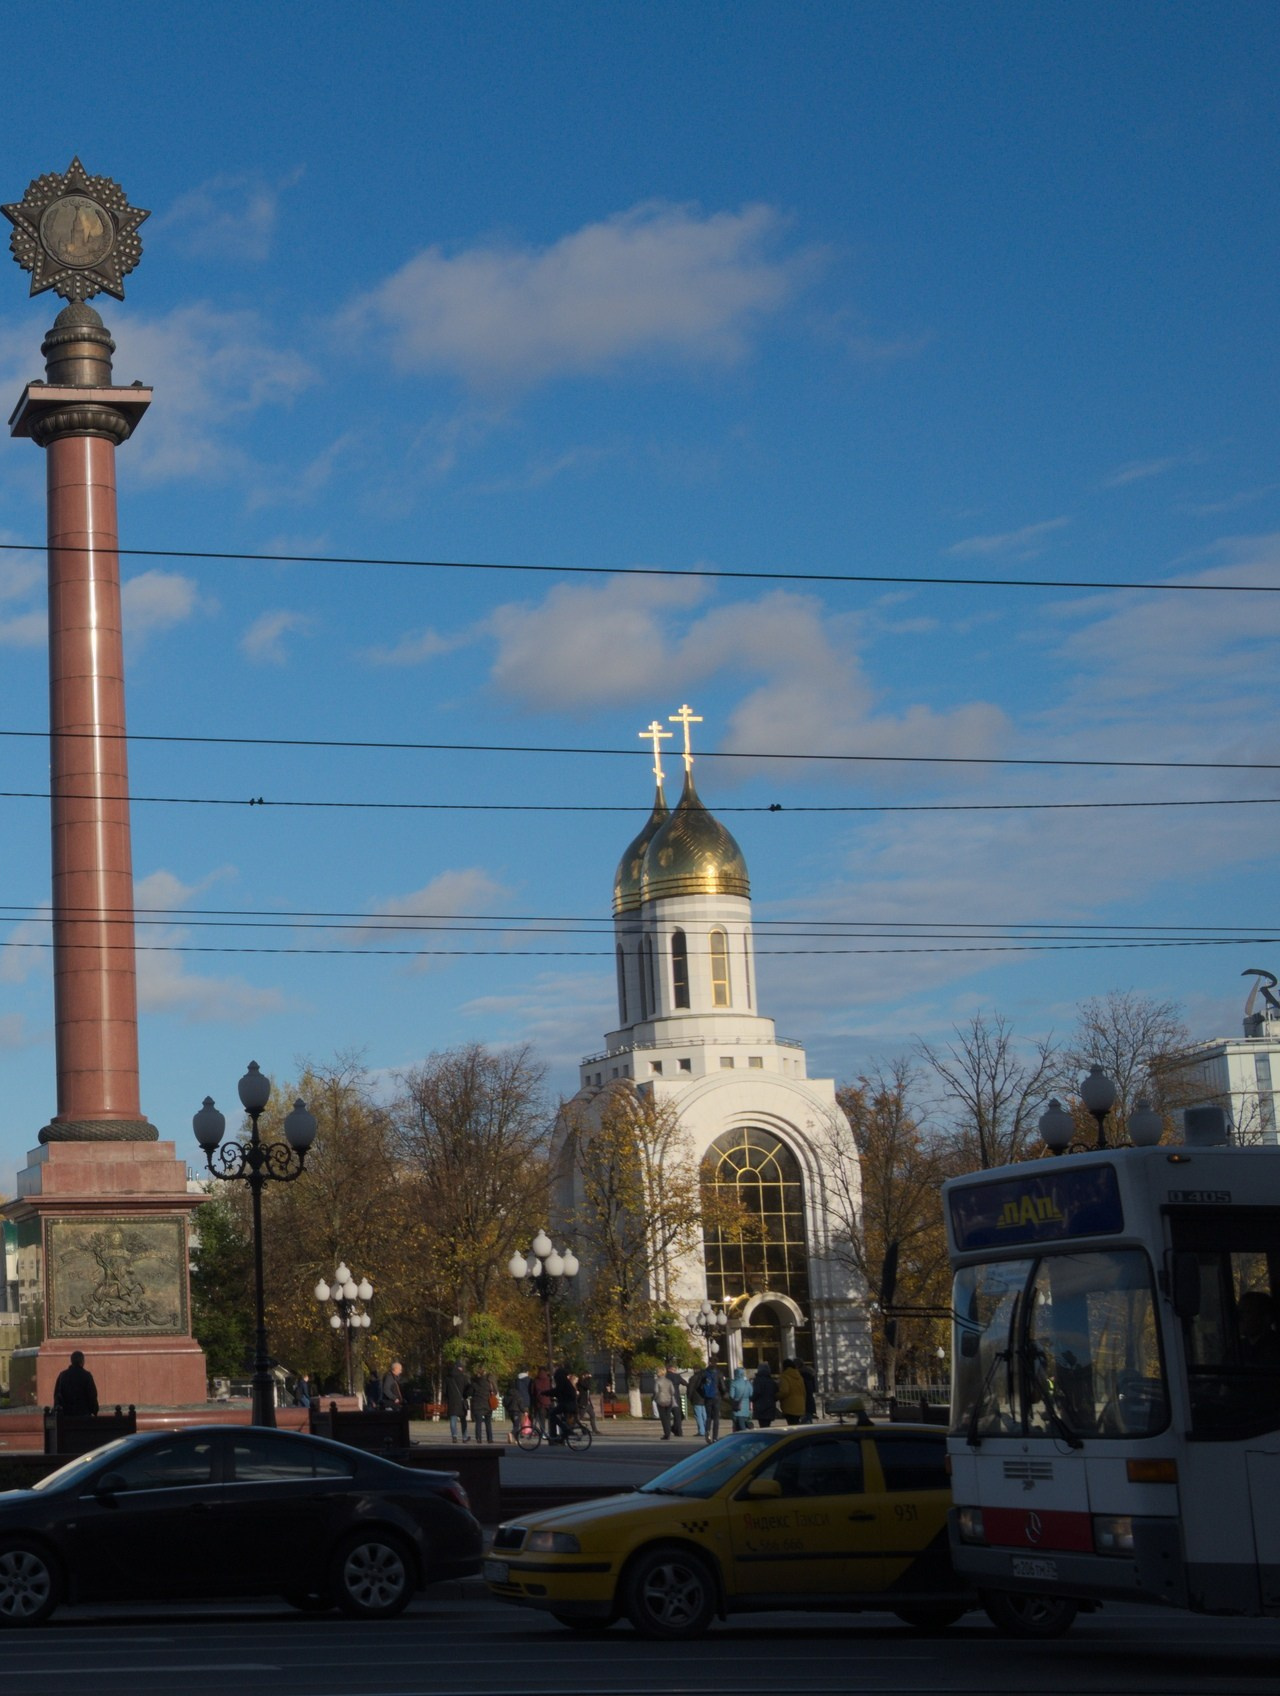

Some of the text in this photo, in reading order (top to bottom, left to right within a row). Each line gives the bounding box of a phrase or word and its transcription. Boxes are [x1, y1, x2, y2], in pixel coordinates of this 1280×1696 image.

[743, 1510, 832, 1531] Яндекс Такси
[894, 1504, 919, 1522] 931
